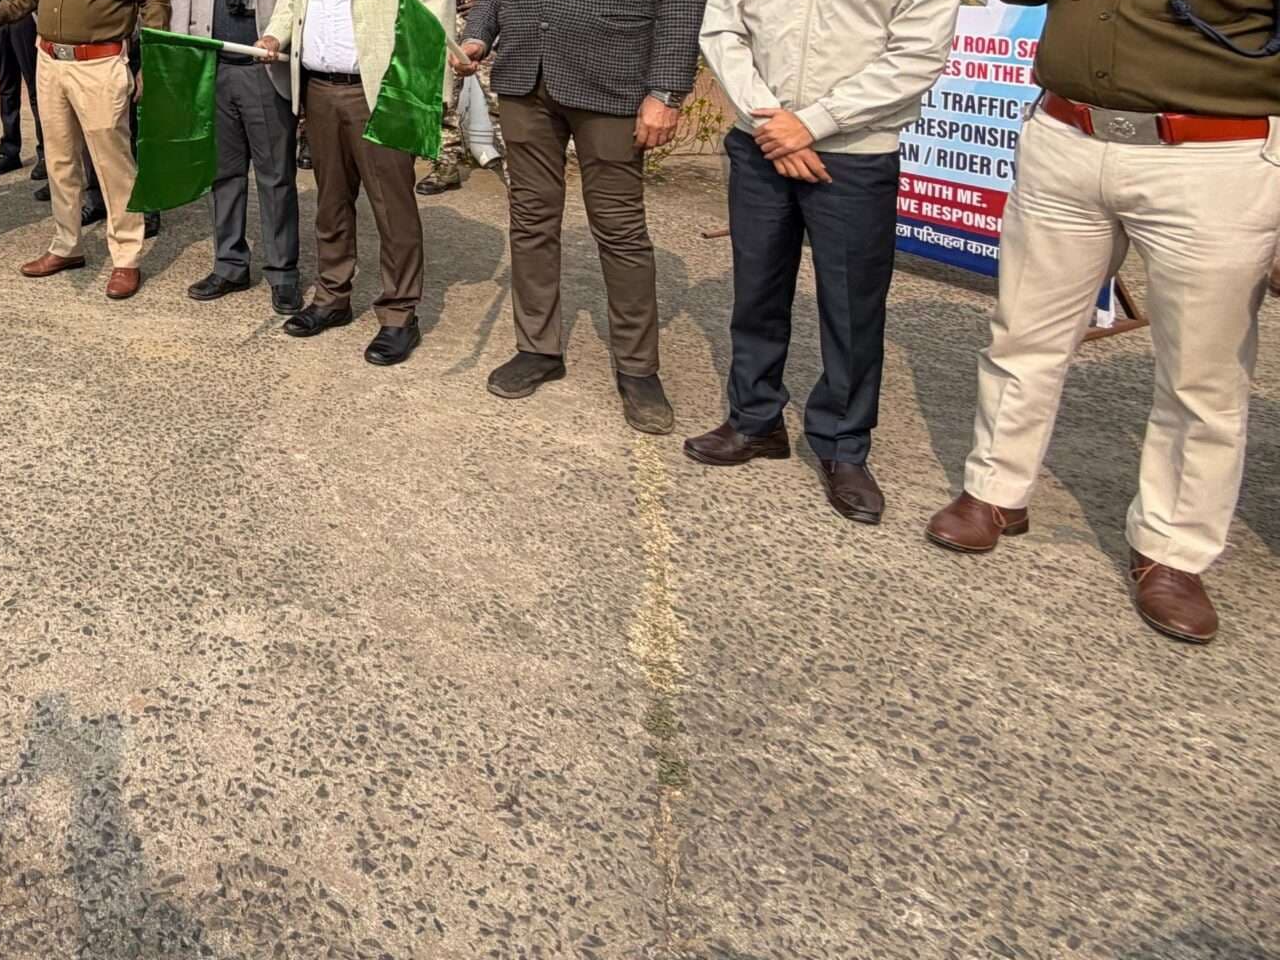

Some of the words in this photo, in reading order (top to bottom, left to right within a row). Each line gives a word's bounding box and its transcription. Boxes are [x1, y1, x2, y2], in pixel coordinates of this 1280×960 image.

[964, 36, 1009, 56] ROAD
[943, 60, 961, 77] ES
[965, 61, 988, 80] ON
[992, 64, 1025, 84] THE
[941, 91, 1018, 119] TRAFFIC
[900, 142, 919, 162] AN
[937, 148, 991, 176] RIDER
[896, 196, 919, 213] IVE
[913, 179, 953, 200] WITH
[957, 188, 988, 208] ME.
[895, 223, 912, 238] ला
[913, 225, 966, 251] परिवहन
